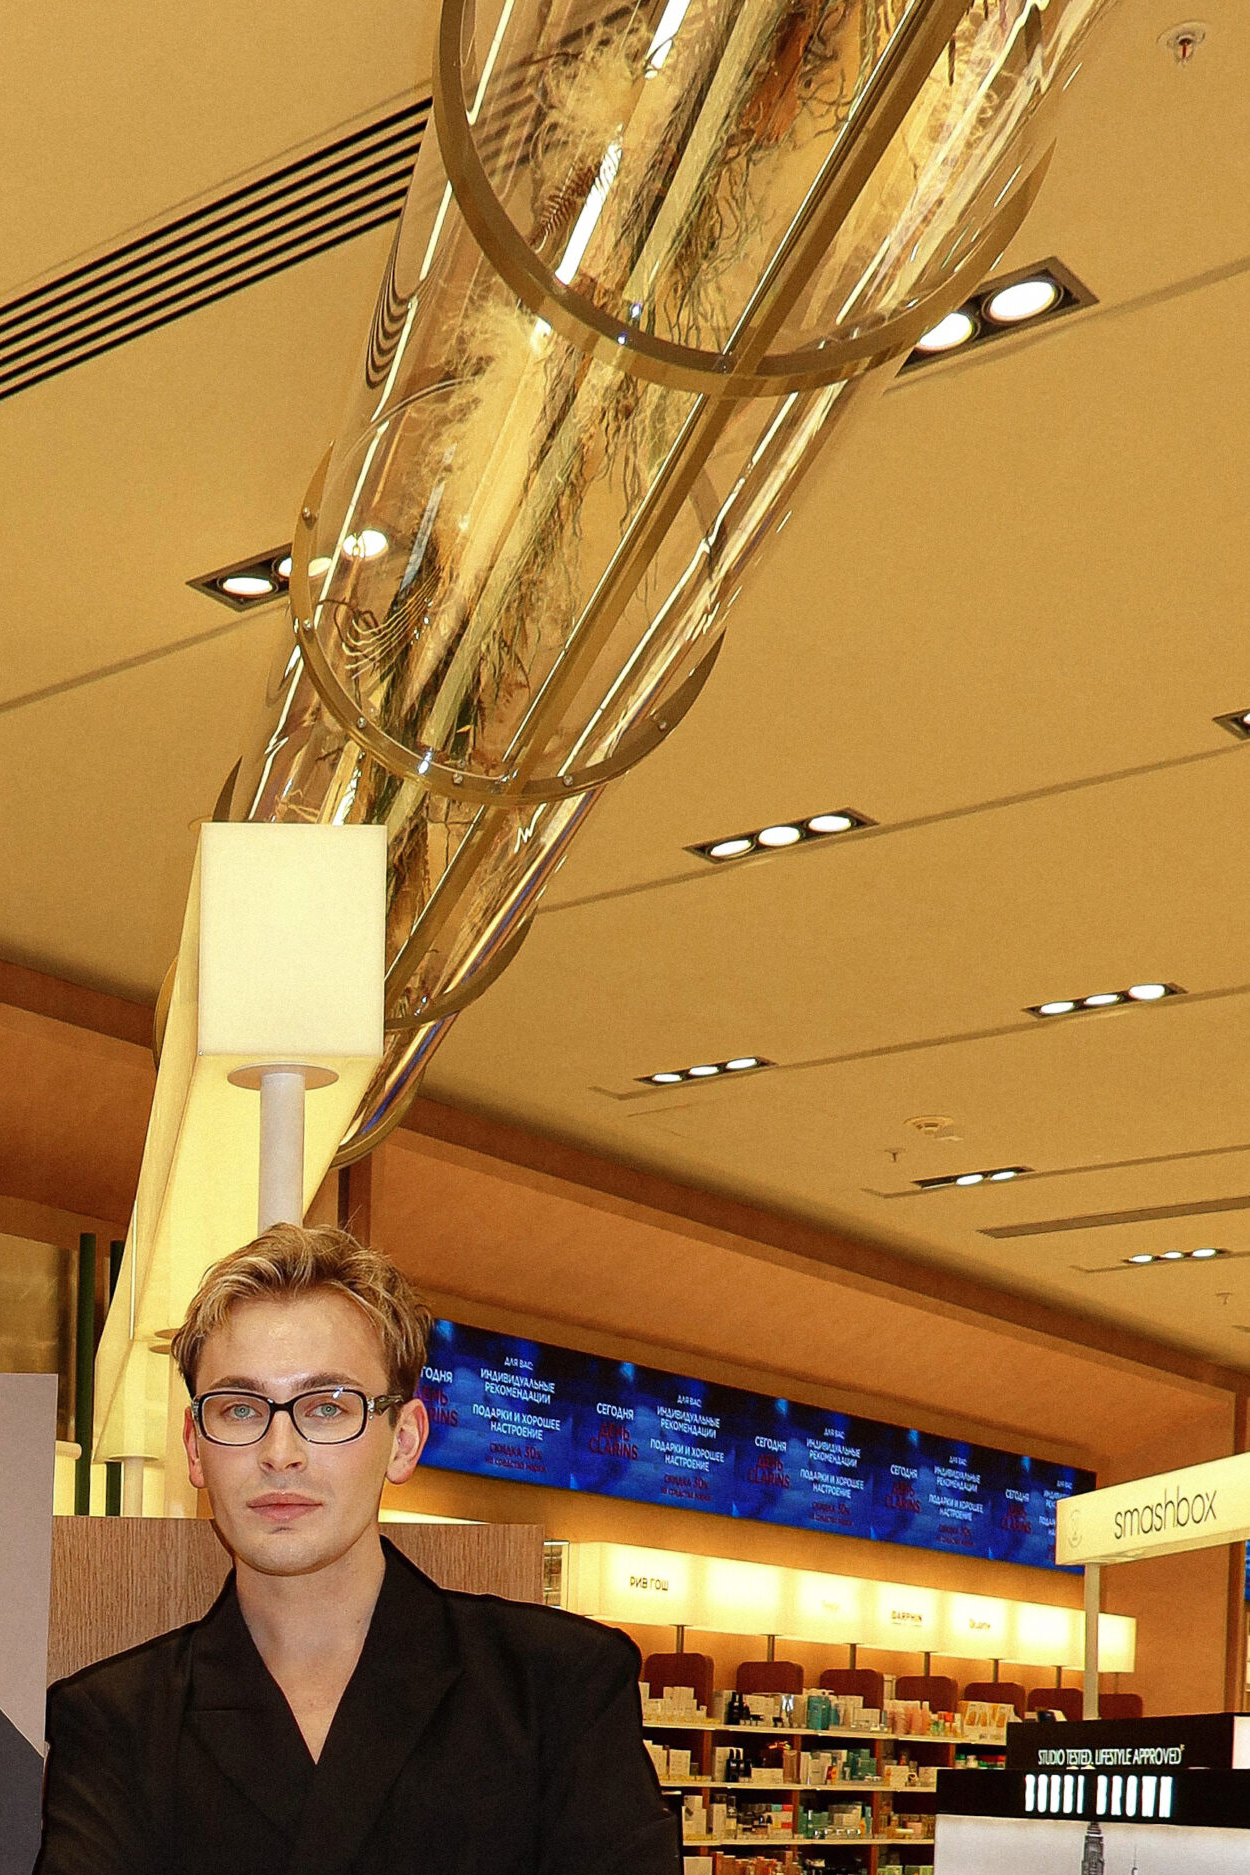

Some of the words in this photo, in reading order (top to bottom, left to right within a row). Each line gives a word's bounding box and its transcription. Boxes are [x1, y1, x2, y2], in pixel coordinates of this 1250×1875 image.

[420, 1366, 453, 1383] ГОДНЯ
[480, 1368, 555, 1394] ИНДИВИДУАЛЬНЫЕ
[485, 1382, 551, 1405] РЕКОМЕНДАЦИИ
[473, 1404, 513, 1421] ПОДАРКИ
[514, 1412, 521, 1422] И
[521, 1413, 561, 1431] ХОРОШЕЕ
[596, 1402, 634, 1420] СЕГОДНЯ
[491, 1421, 543, 1440] НАСТРОЕНИЕ
[590, 1437, 638, 1460] CLARINS
[754, 1436, 787, 1452] СЕГОДНЯ
[664, 1455, 709, 1472] НАСТРОЕНИЕ
[1114, 1485, 1217, 1540] smashbox
[630, 1576, 648, 1589] РИВ
[650, 1578, 669, 1591] ГОШ
[1038, 1749, 1065, 1765] STUDIO
[1095, 1748, 1132, 1765] LIFESTYLE
